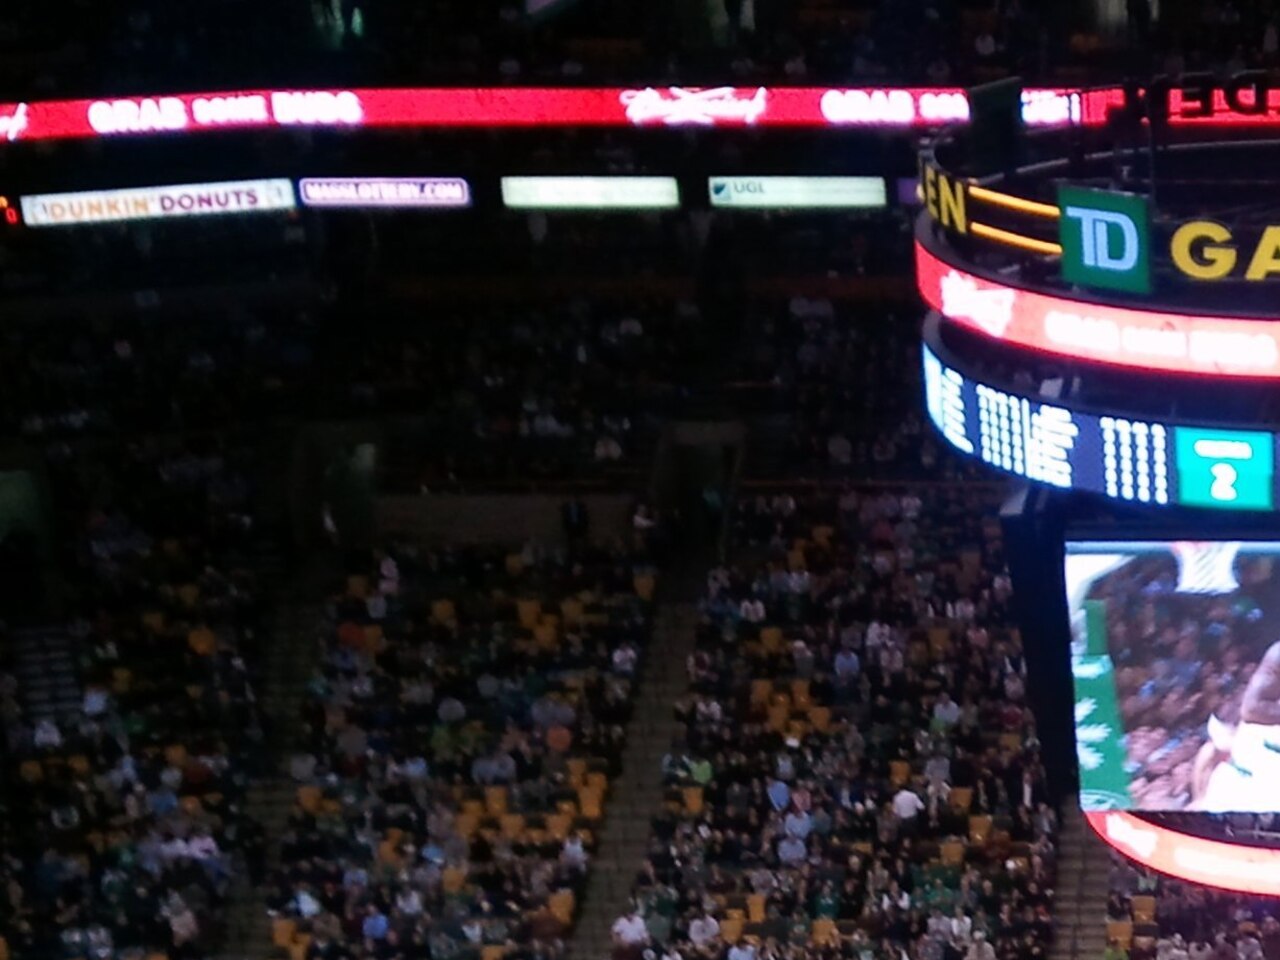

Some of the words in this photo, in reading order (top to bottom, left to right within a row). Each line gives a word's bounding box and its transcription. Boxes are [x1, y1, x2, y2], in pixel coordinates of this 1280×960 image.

[160, 188, 258, 211] DONUTS
[917, 165, 967, 234] EN
[1066, 205, 1140, 271] TD
[1210, 462, 1238, 501] 2
